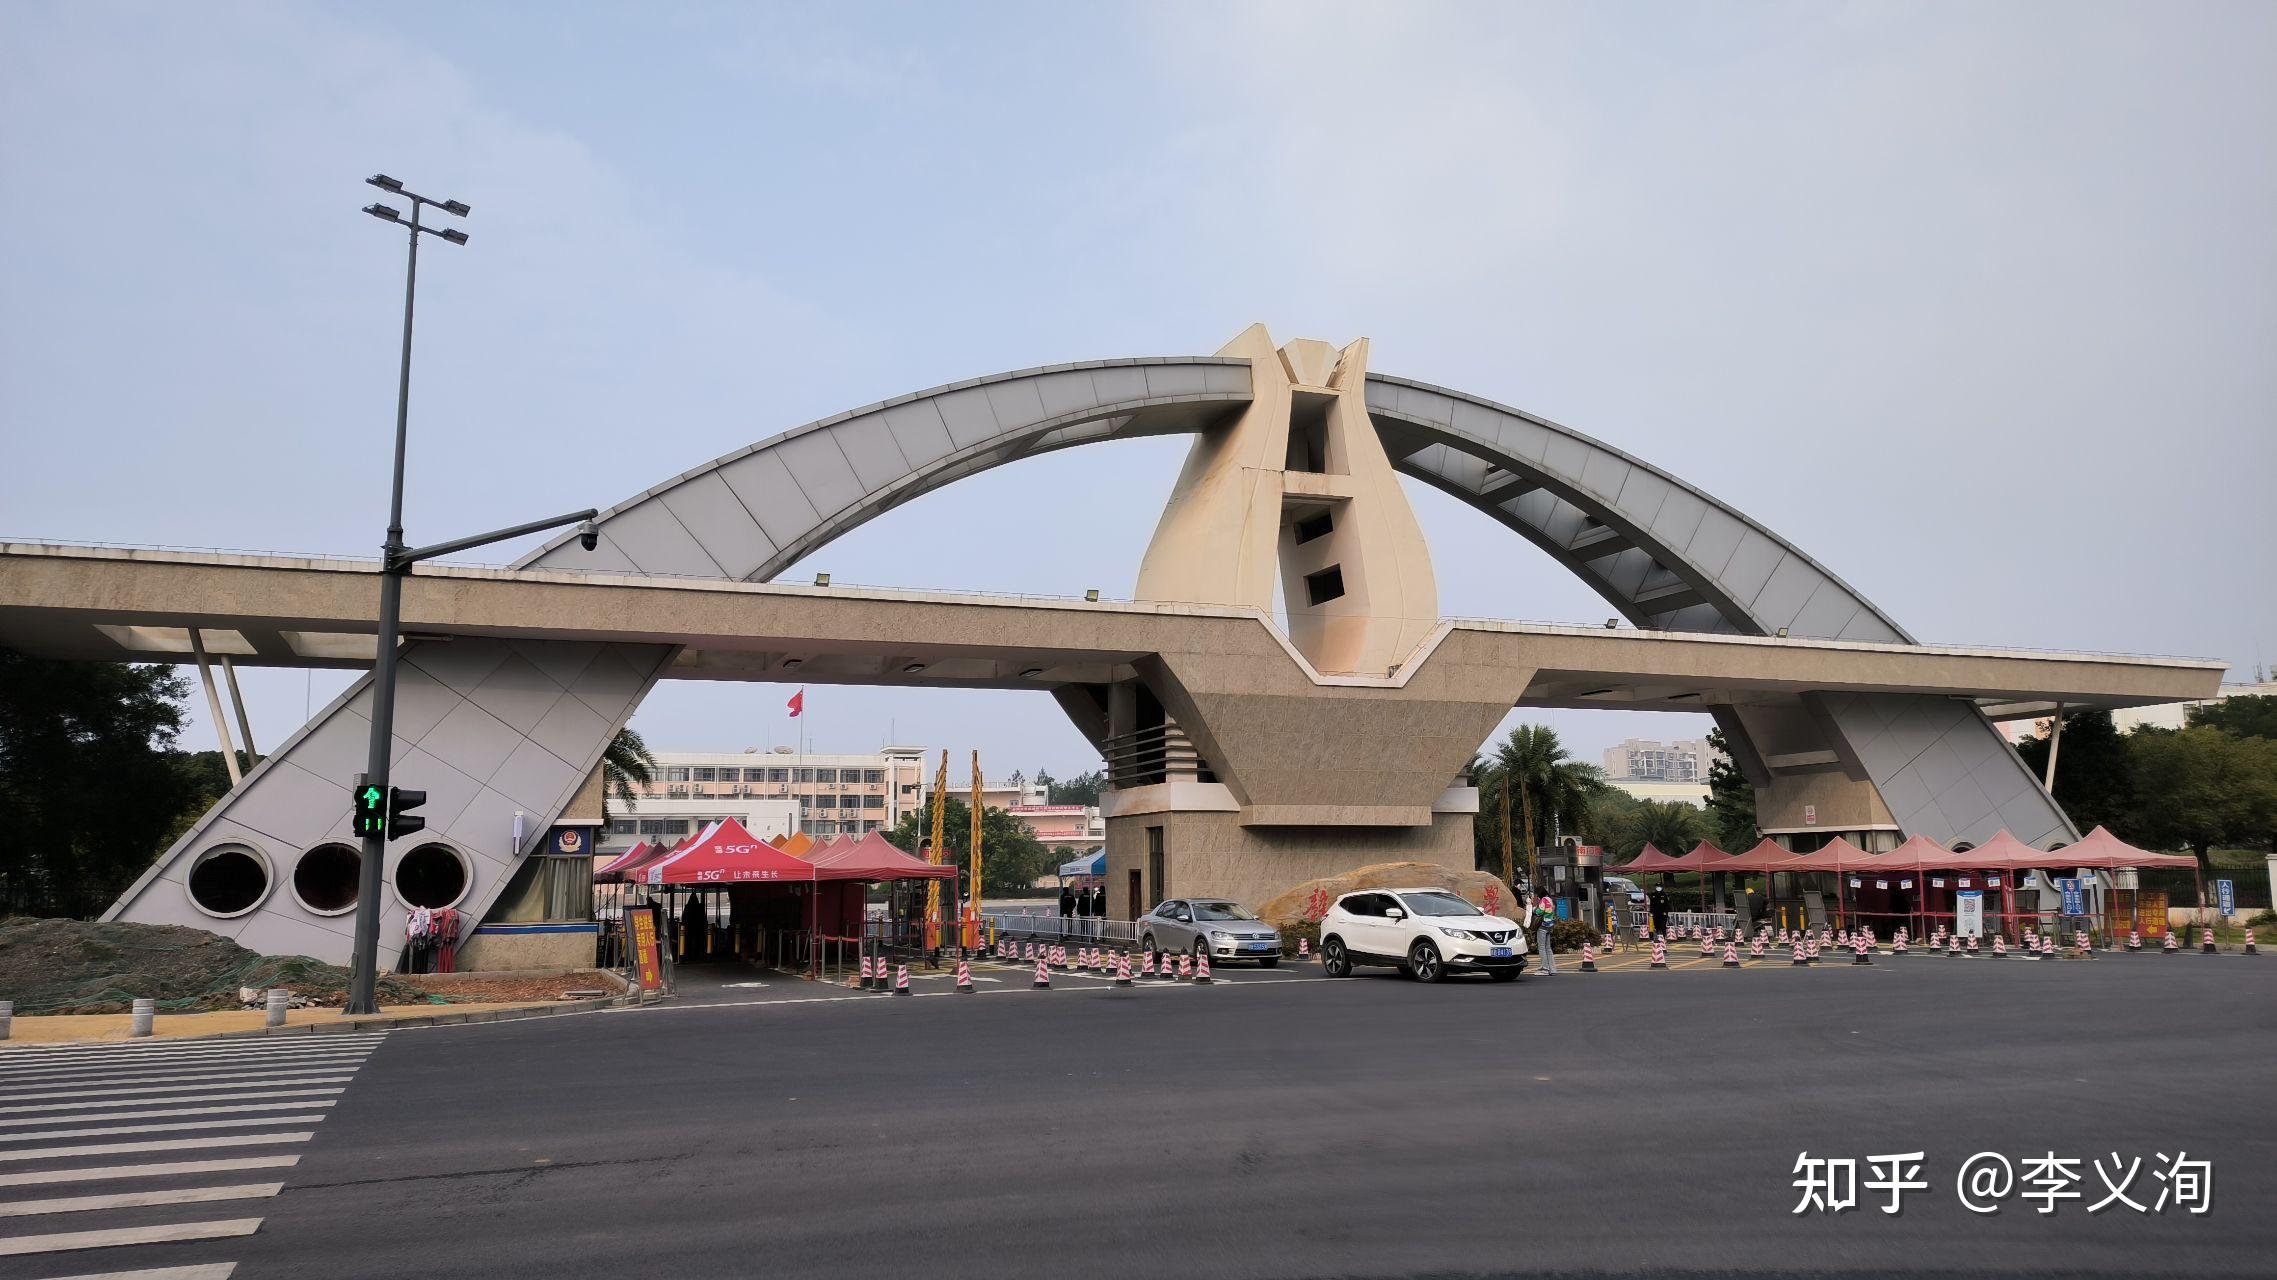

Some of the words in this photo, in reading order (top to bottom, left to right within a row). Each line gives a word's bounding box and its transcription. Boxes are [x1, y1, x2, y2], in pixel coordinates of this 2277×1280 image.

[733, 870, 778, 879] 让未来生长
[2221, 881, 2231, 907] 人行通道
